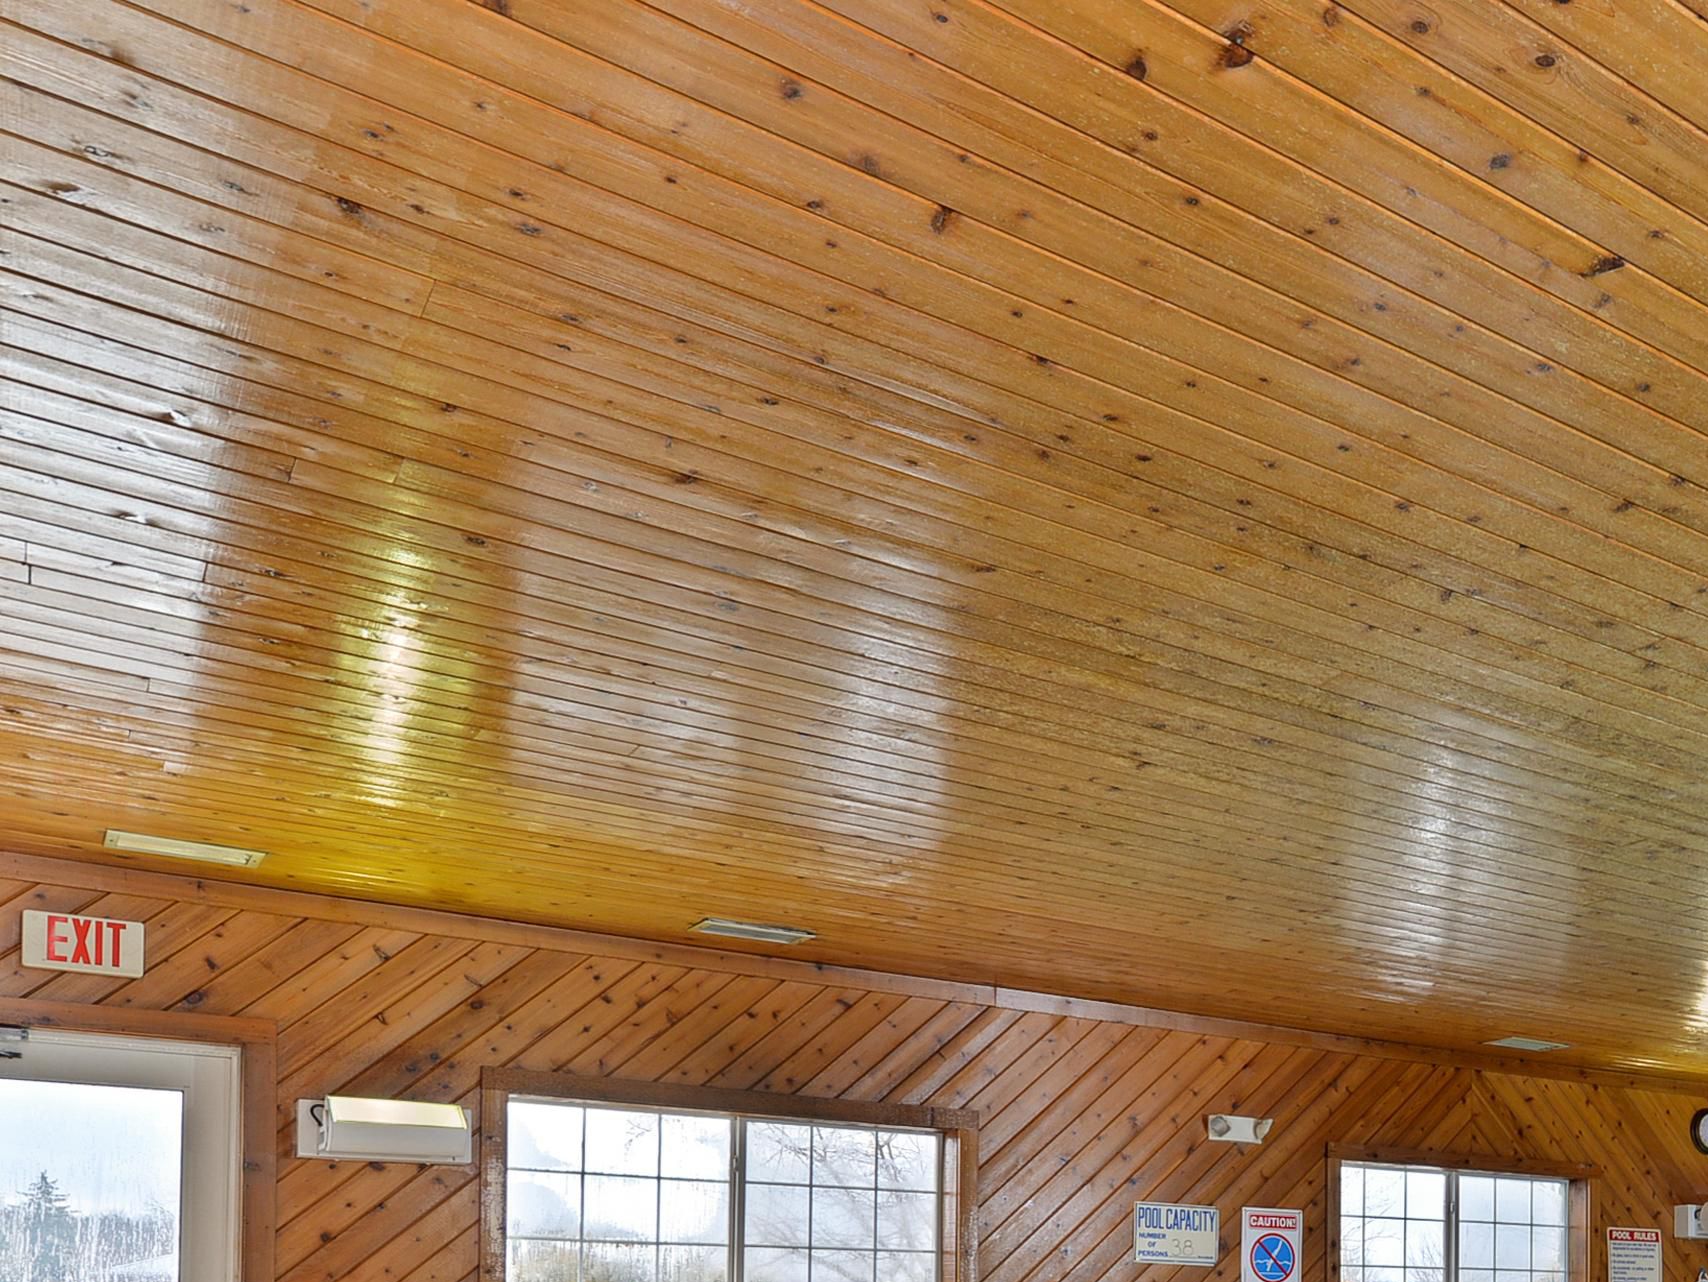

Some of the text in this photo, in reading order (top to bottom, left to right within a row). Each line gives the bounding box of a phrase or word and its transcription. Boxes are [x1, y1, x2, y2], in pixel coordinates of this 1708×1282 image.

[47, 915, 127, 968] EXIT
[1138, 1206, 1216, 1232] POOL CAPACITY
[1250, 1215, 1296, 1227] CAUTION!
[1612, 1231, 1656, 1240] POOL RULES
[1172, 1238, 1193, 1256] 38
